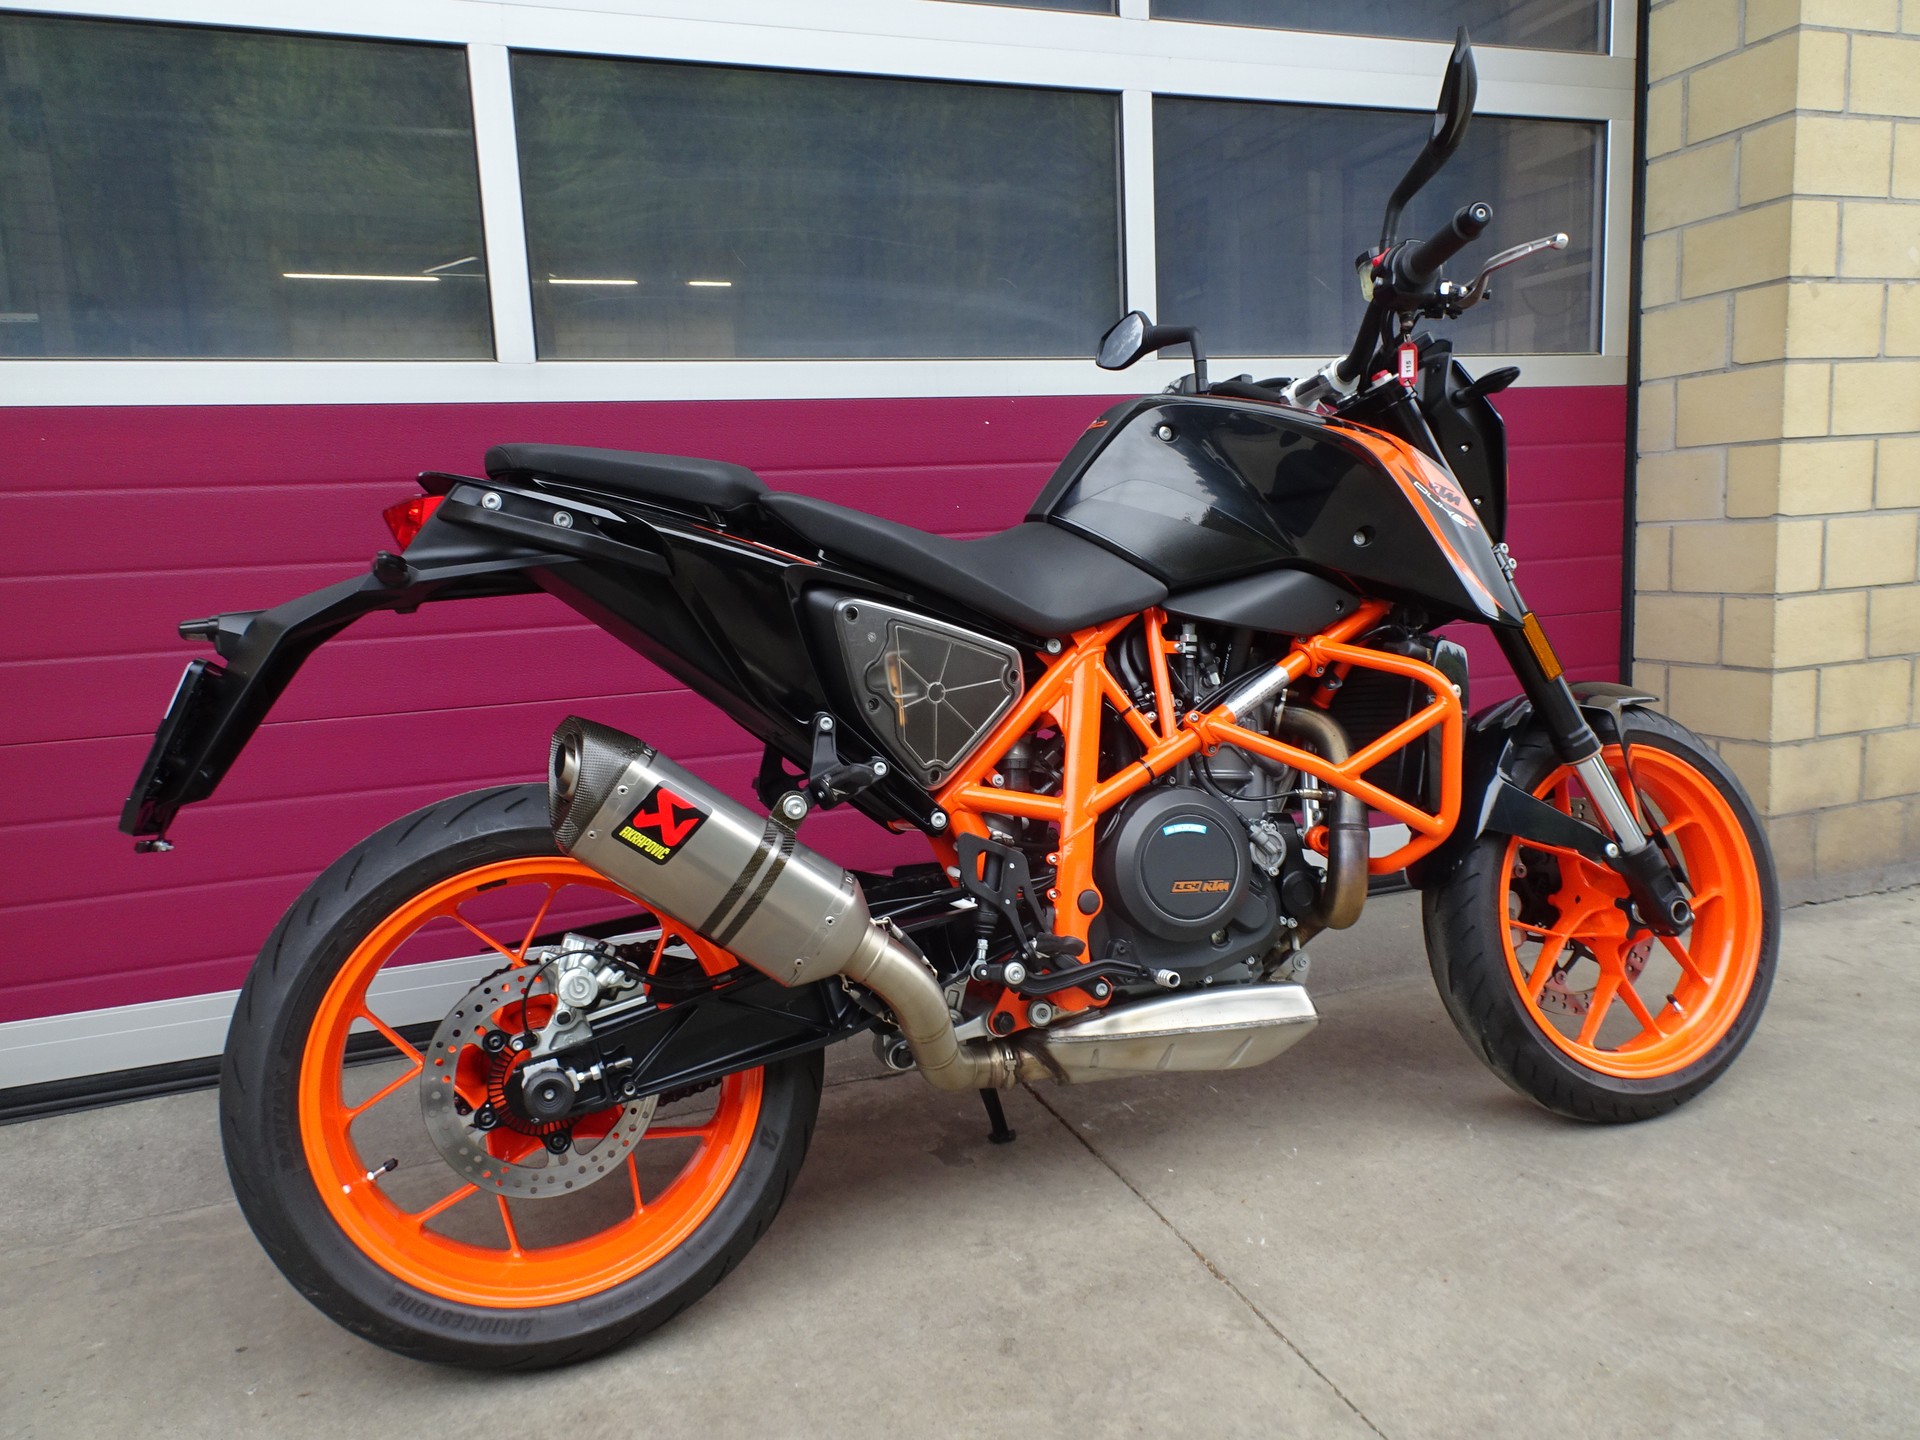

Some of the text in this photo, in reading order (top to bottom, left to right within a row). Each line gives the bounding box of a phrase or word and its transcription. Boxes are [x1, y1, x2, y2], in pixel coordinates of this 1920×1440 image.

[1413, 480, 1467, 527] DUKE
[1428, 481, 1461, 507] KTM
[1202, 880, 1230, 892] KTM
